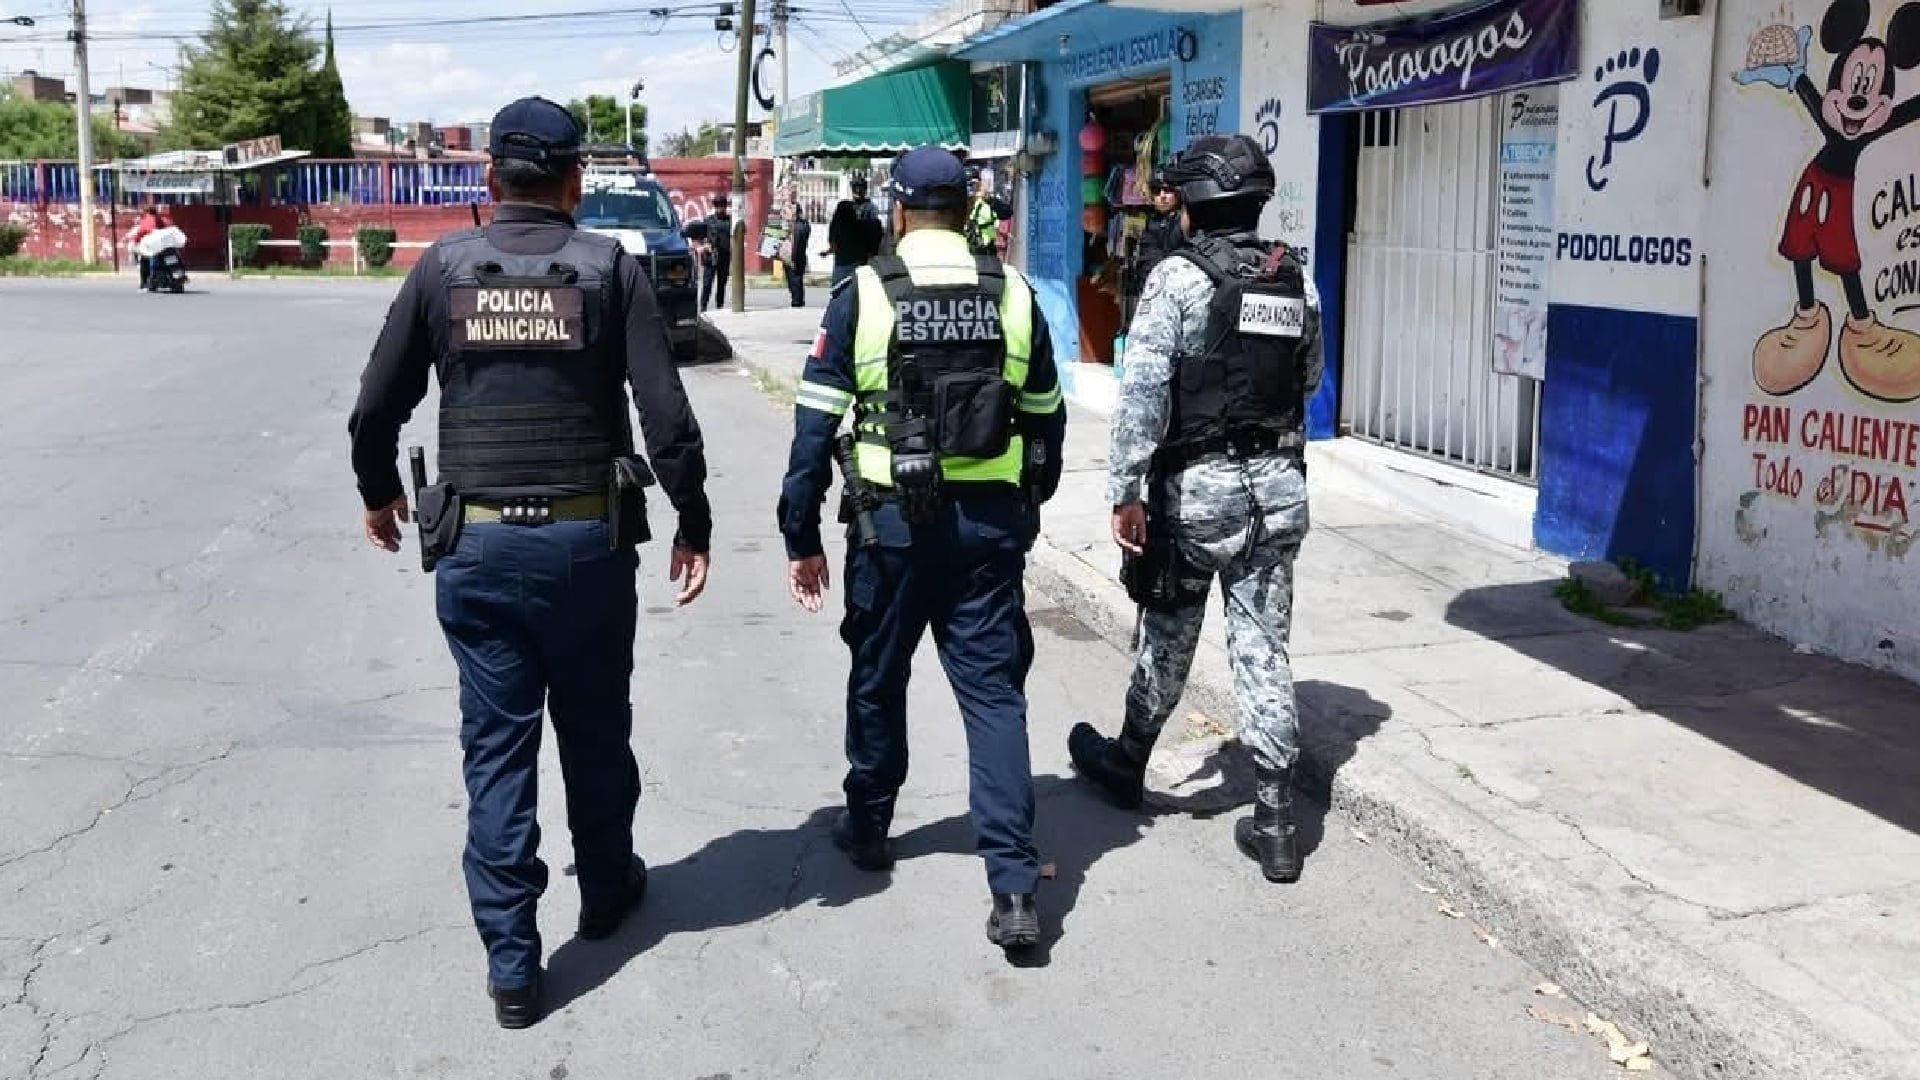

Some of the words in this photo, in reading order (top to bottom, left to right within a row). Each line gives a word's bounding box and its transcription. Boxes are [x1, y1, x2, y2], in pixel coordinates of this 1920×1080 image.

[1556, 233, 1692, 267] PODOLOGOS
[477, 290, 554, 313] POLICIA
[895, 295, 1000, 321] POLICÍA
[1242, 302, 1272, 323] GUARDIA
[1273, 305, 1302, 327] NACIONAL
[465, 317, 571, 341] MUNICIPAL
[896, 321, 1000, 341] ESTATAL
[1743, 403, 1790, 444] PAN
[1801, 408, 1920, 468] CALIENTE
[1752, 453, 1803, 498] Todo
[1851, 469, 1909, 524] DIA
